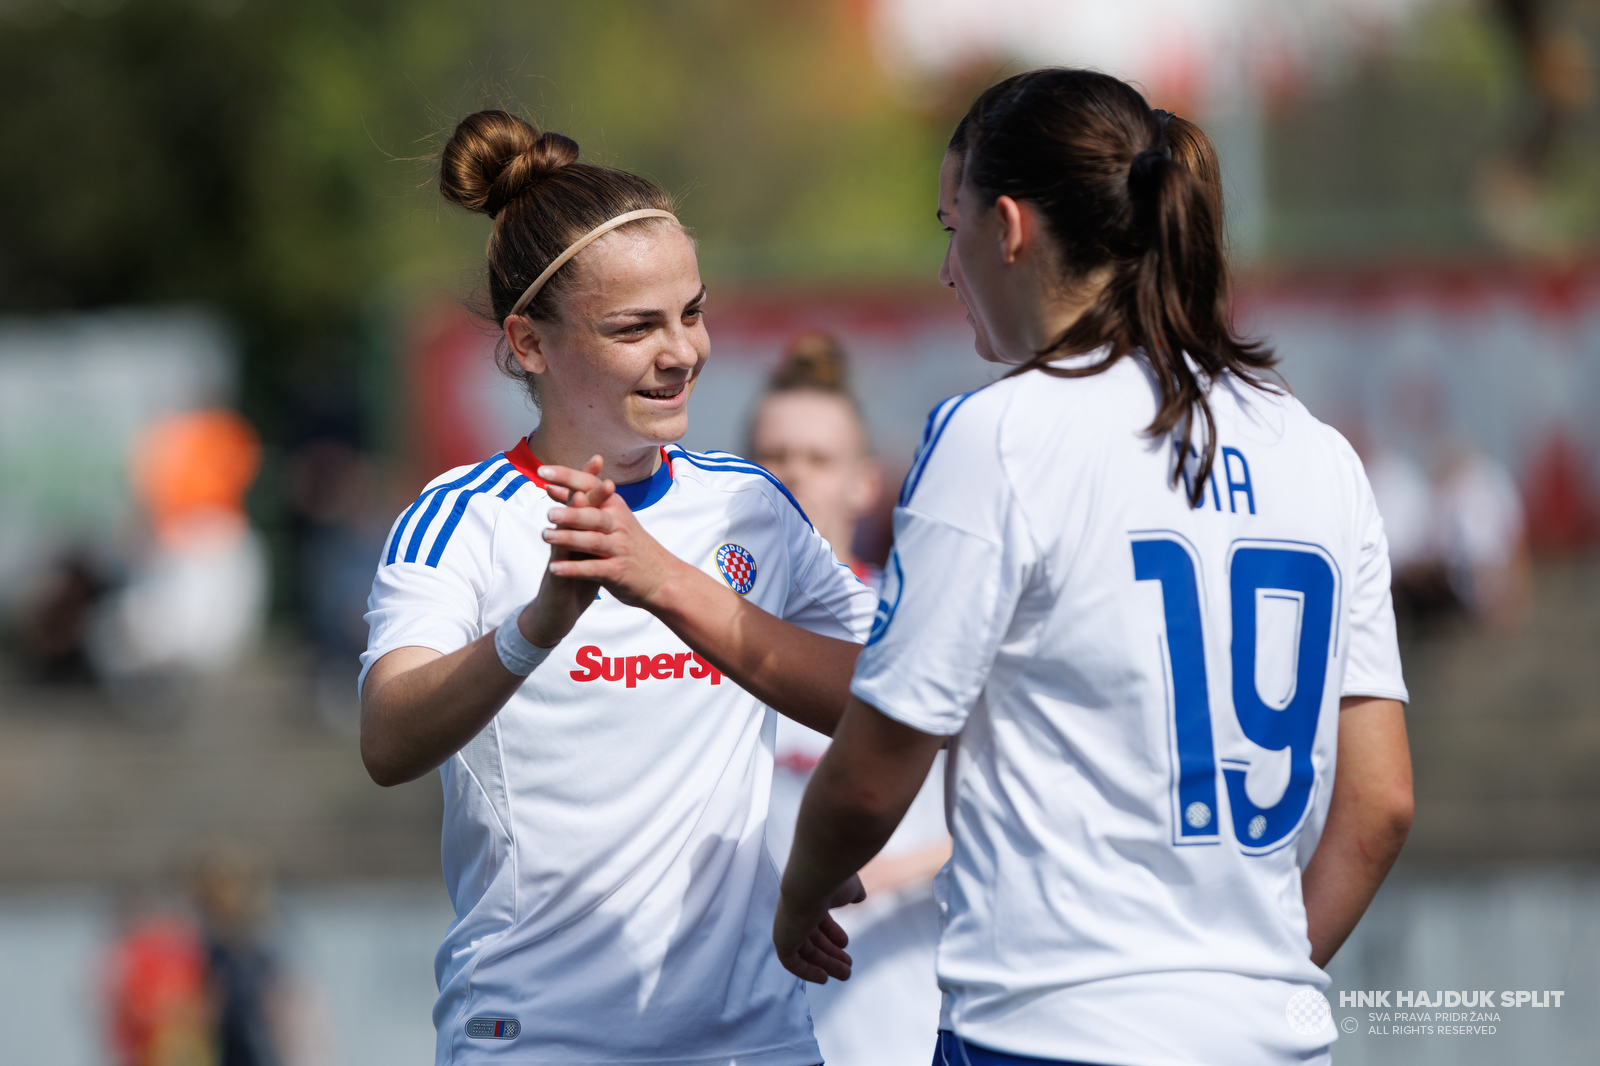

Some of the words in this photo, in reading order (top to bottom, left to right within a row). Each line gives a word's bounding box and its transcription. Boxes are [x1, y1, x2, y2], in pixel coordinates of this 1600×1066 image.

[717, 544, 749, 562] HAJDUK
[731, 580, 752, 593] SPLIT
[1128, 530, 1342, 856] 19
